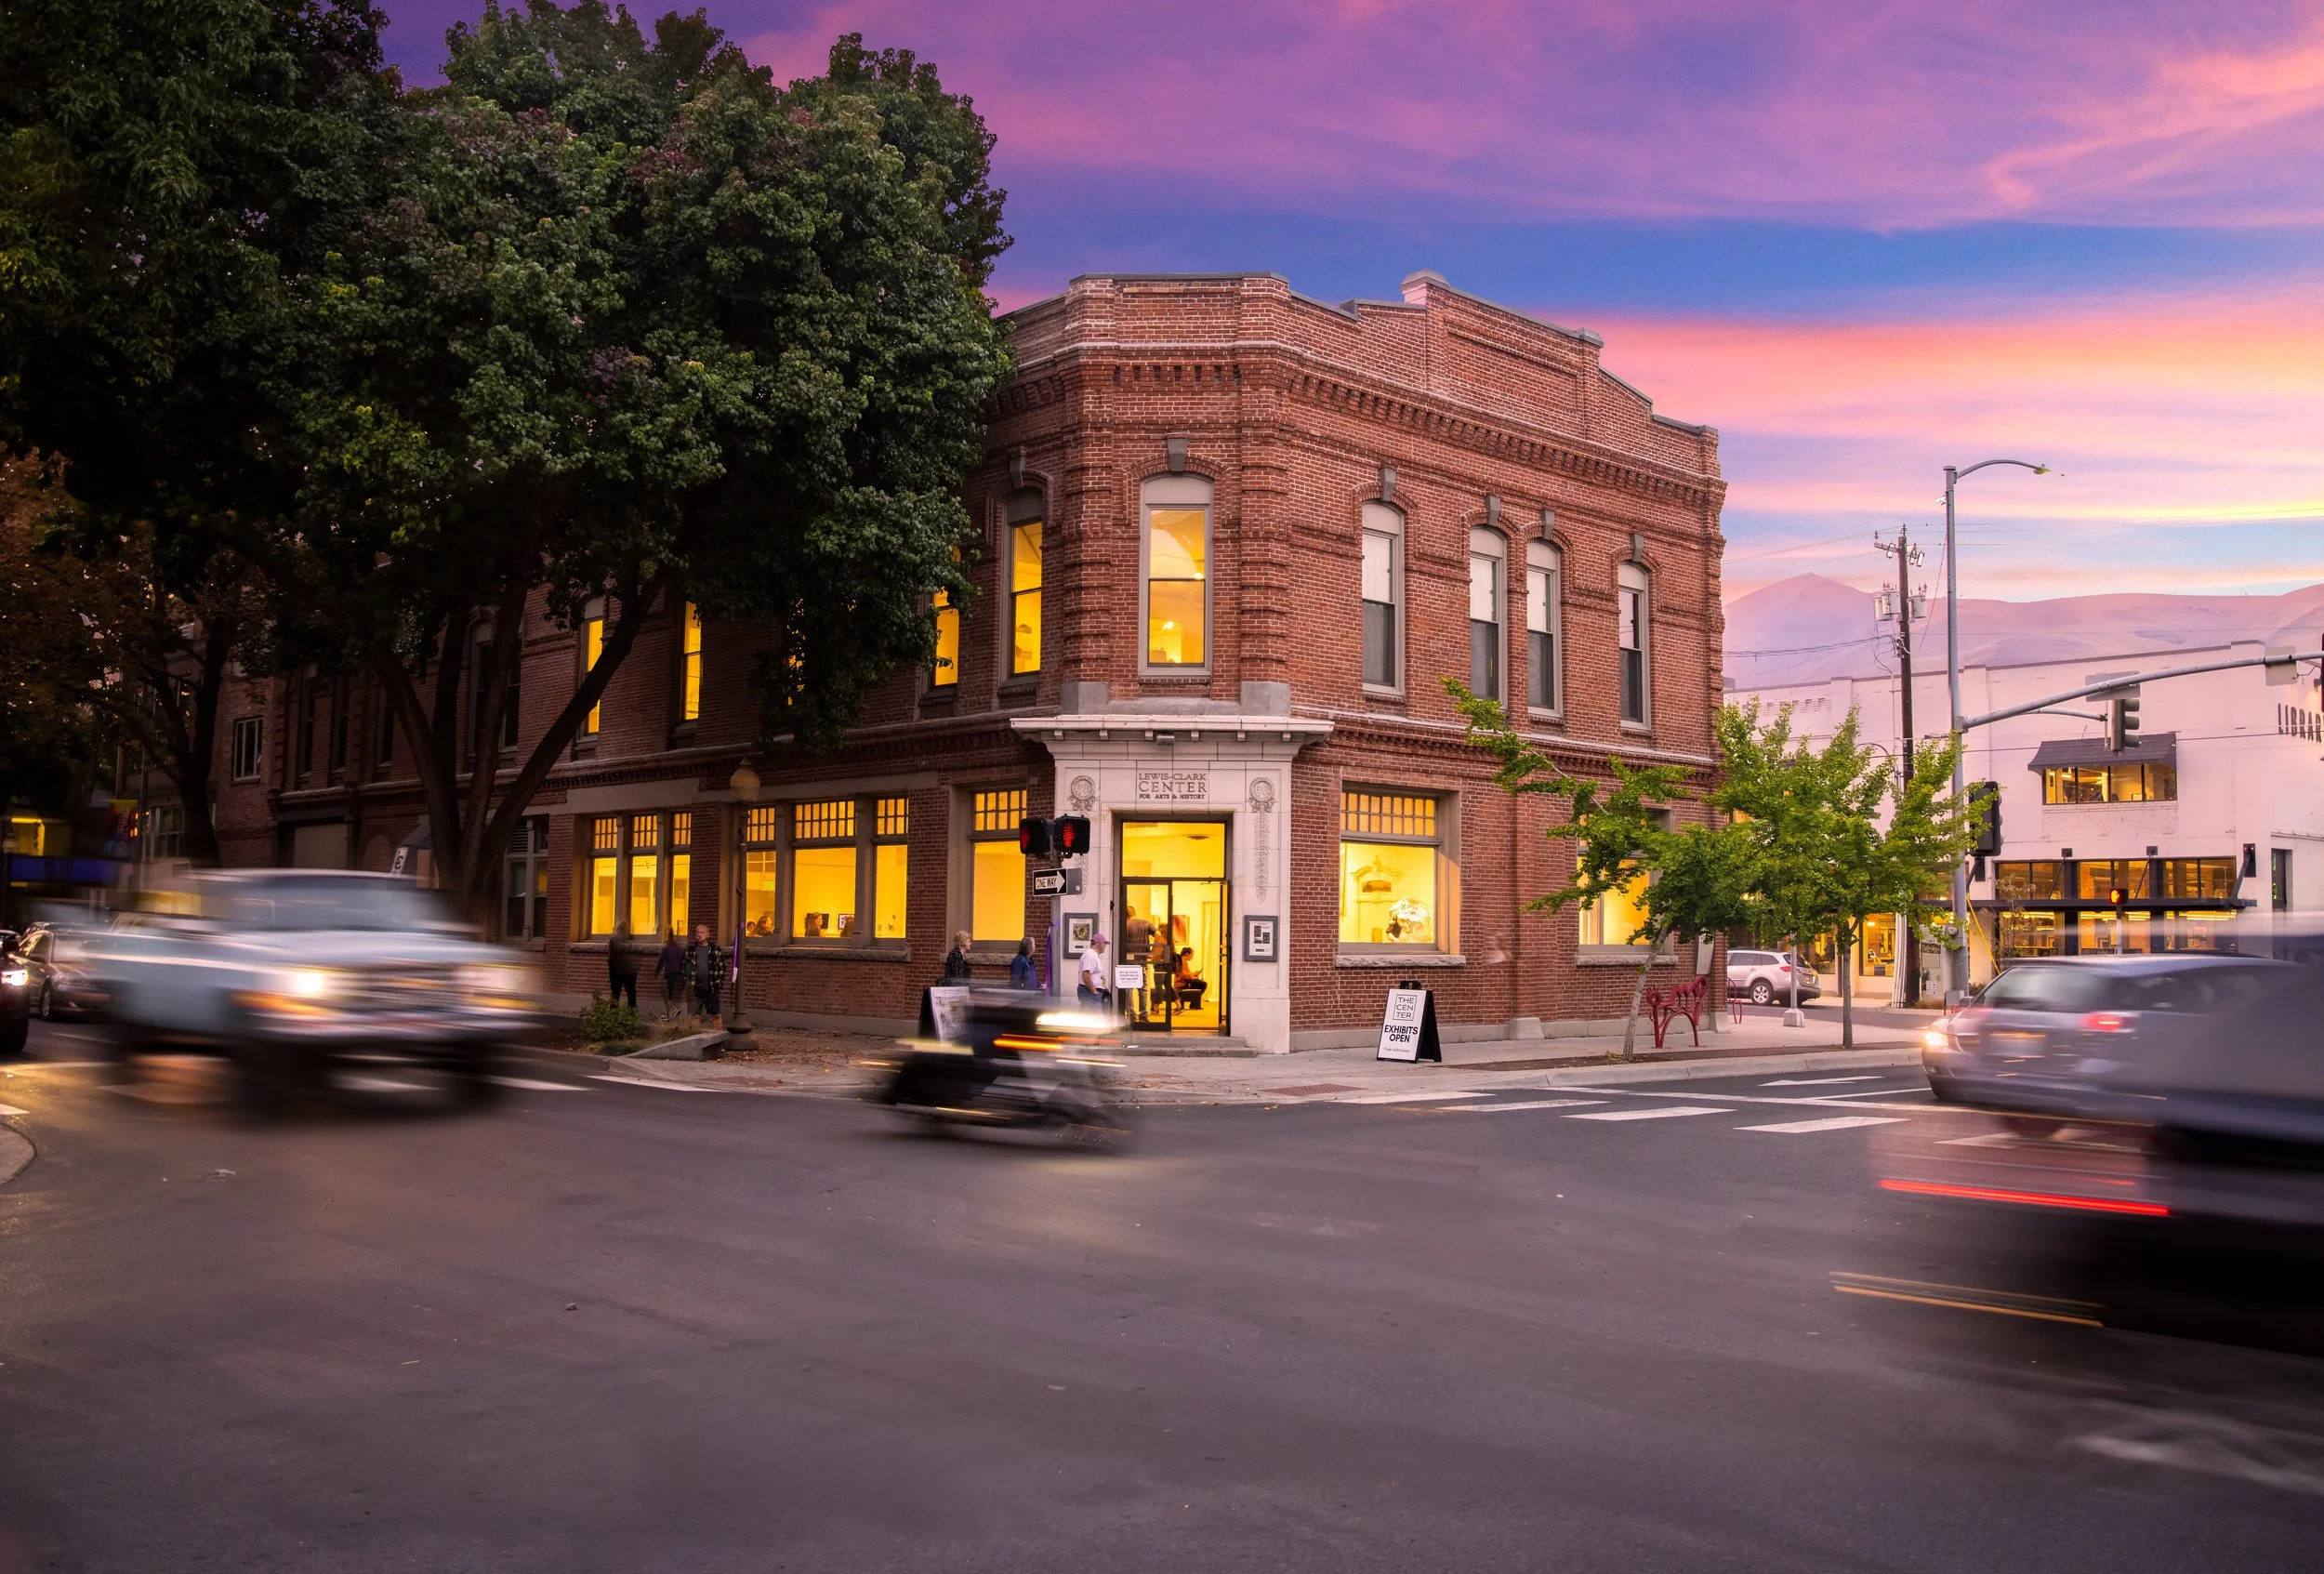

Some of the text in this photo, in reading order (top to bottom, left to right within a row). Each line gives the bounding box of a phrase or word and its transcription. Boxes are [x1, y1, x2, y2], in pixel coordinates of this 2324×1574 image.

[2278, 703, 2324, 743] LIBRAR
[1138, 781, 1208, 792] CENTER
[1037, 877, 1057, 888] ONE WAY
[1384, 1025, 1419, 1035] EXHIBITS
[1389, 1034, 1410, 1042] OPEN
